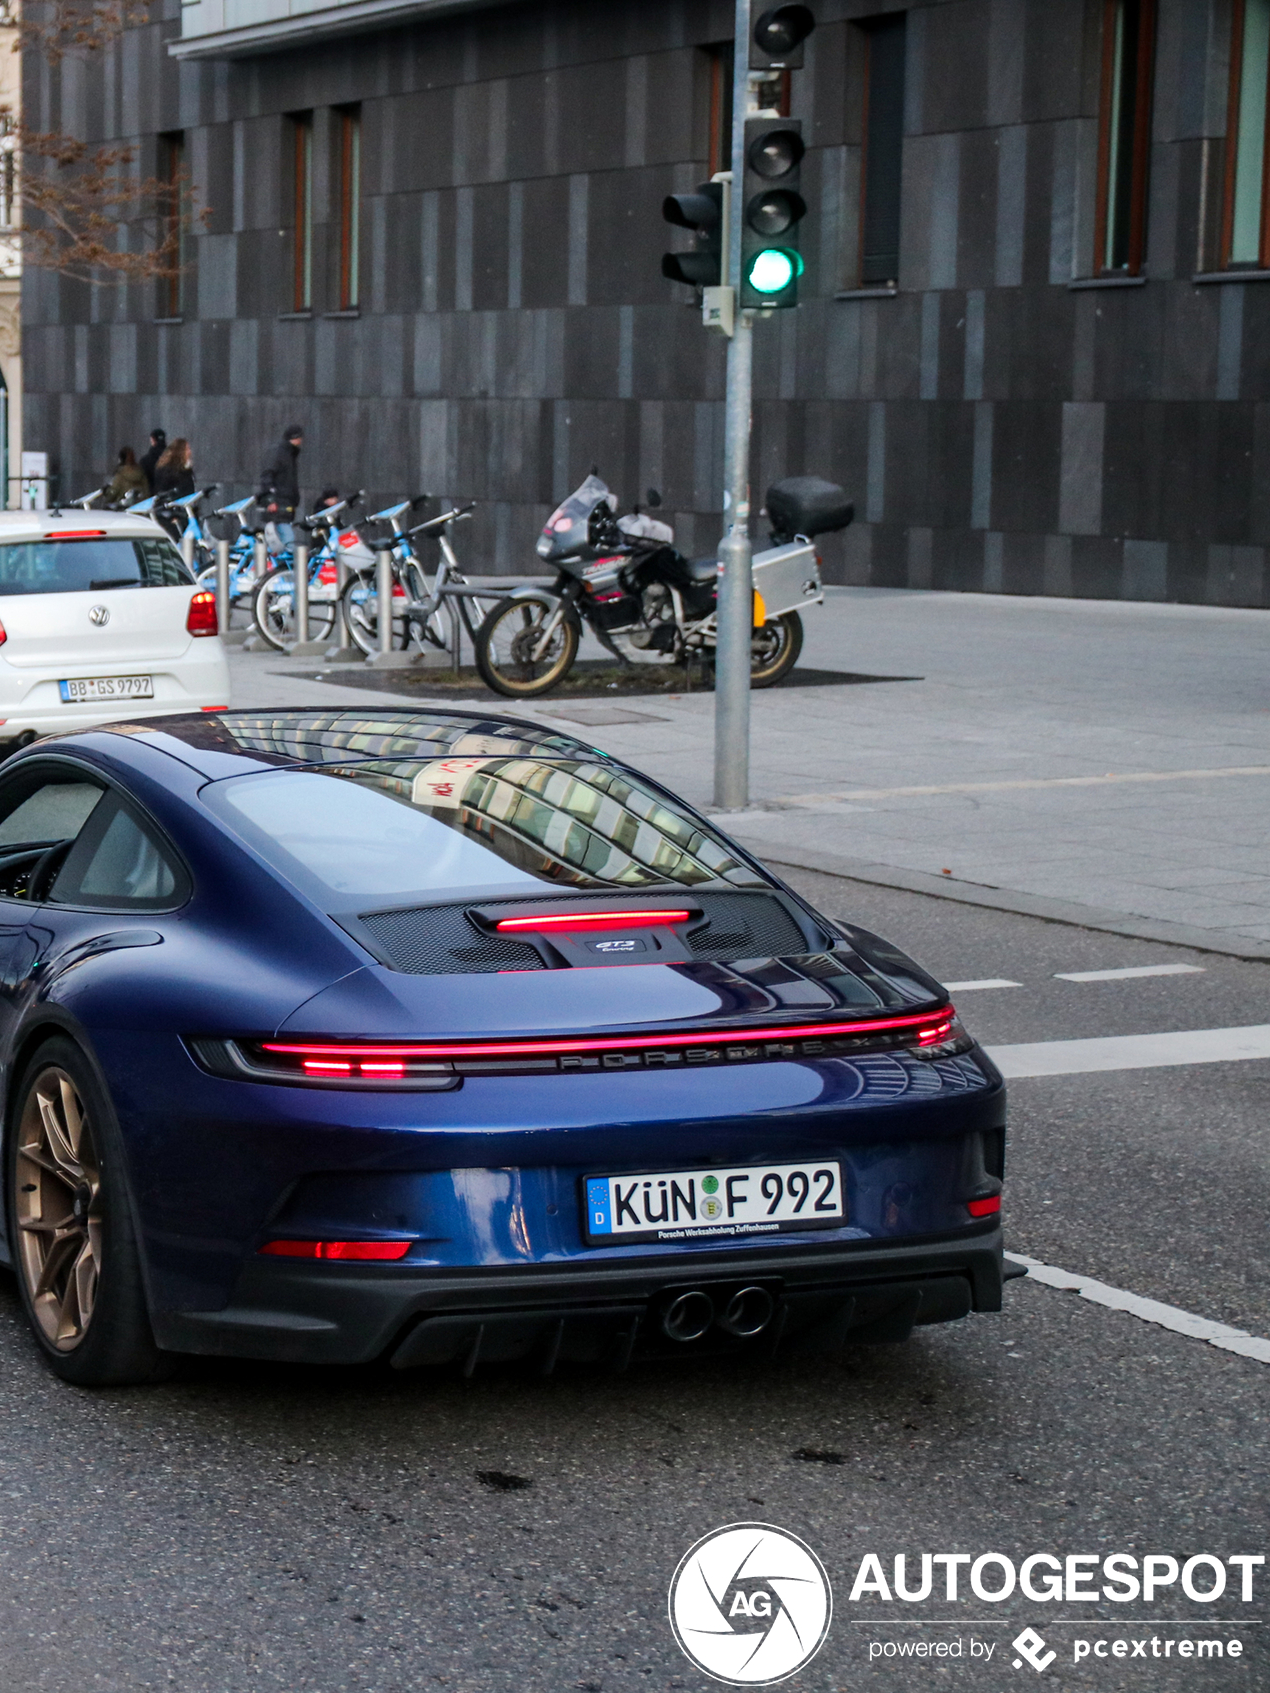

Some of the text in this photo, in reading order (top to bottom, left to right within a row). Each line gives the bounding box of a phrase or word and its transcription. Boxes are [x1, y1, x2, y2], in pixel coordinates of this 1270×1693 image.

[69, 678, 150, 697] BB GS 9797
[595, 940, 636, 949] GT3
[559, 1041, 825, 1069] PORSCHE
[594, 1212, 605, 1225] D
[725, 1174, 750, 1218] F
[759, 1169, 837, 1216] 992
[658, 1223, 780, 1239] Porsche Werksabholung Zuffenhausen
